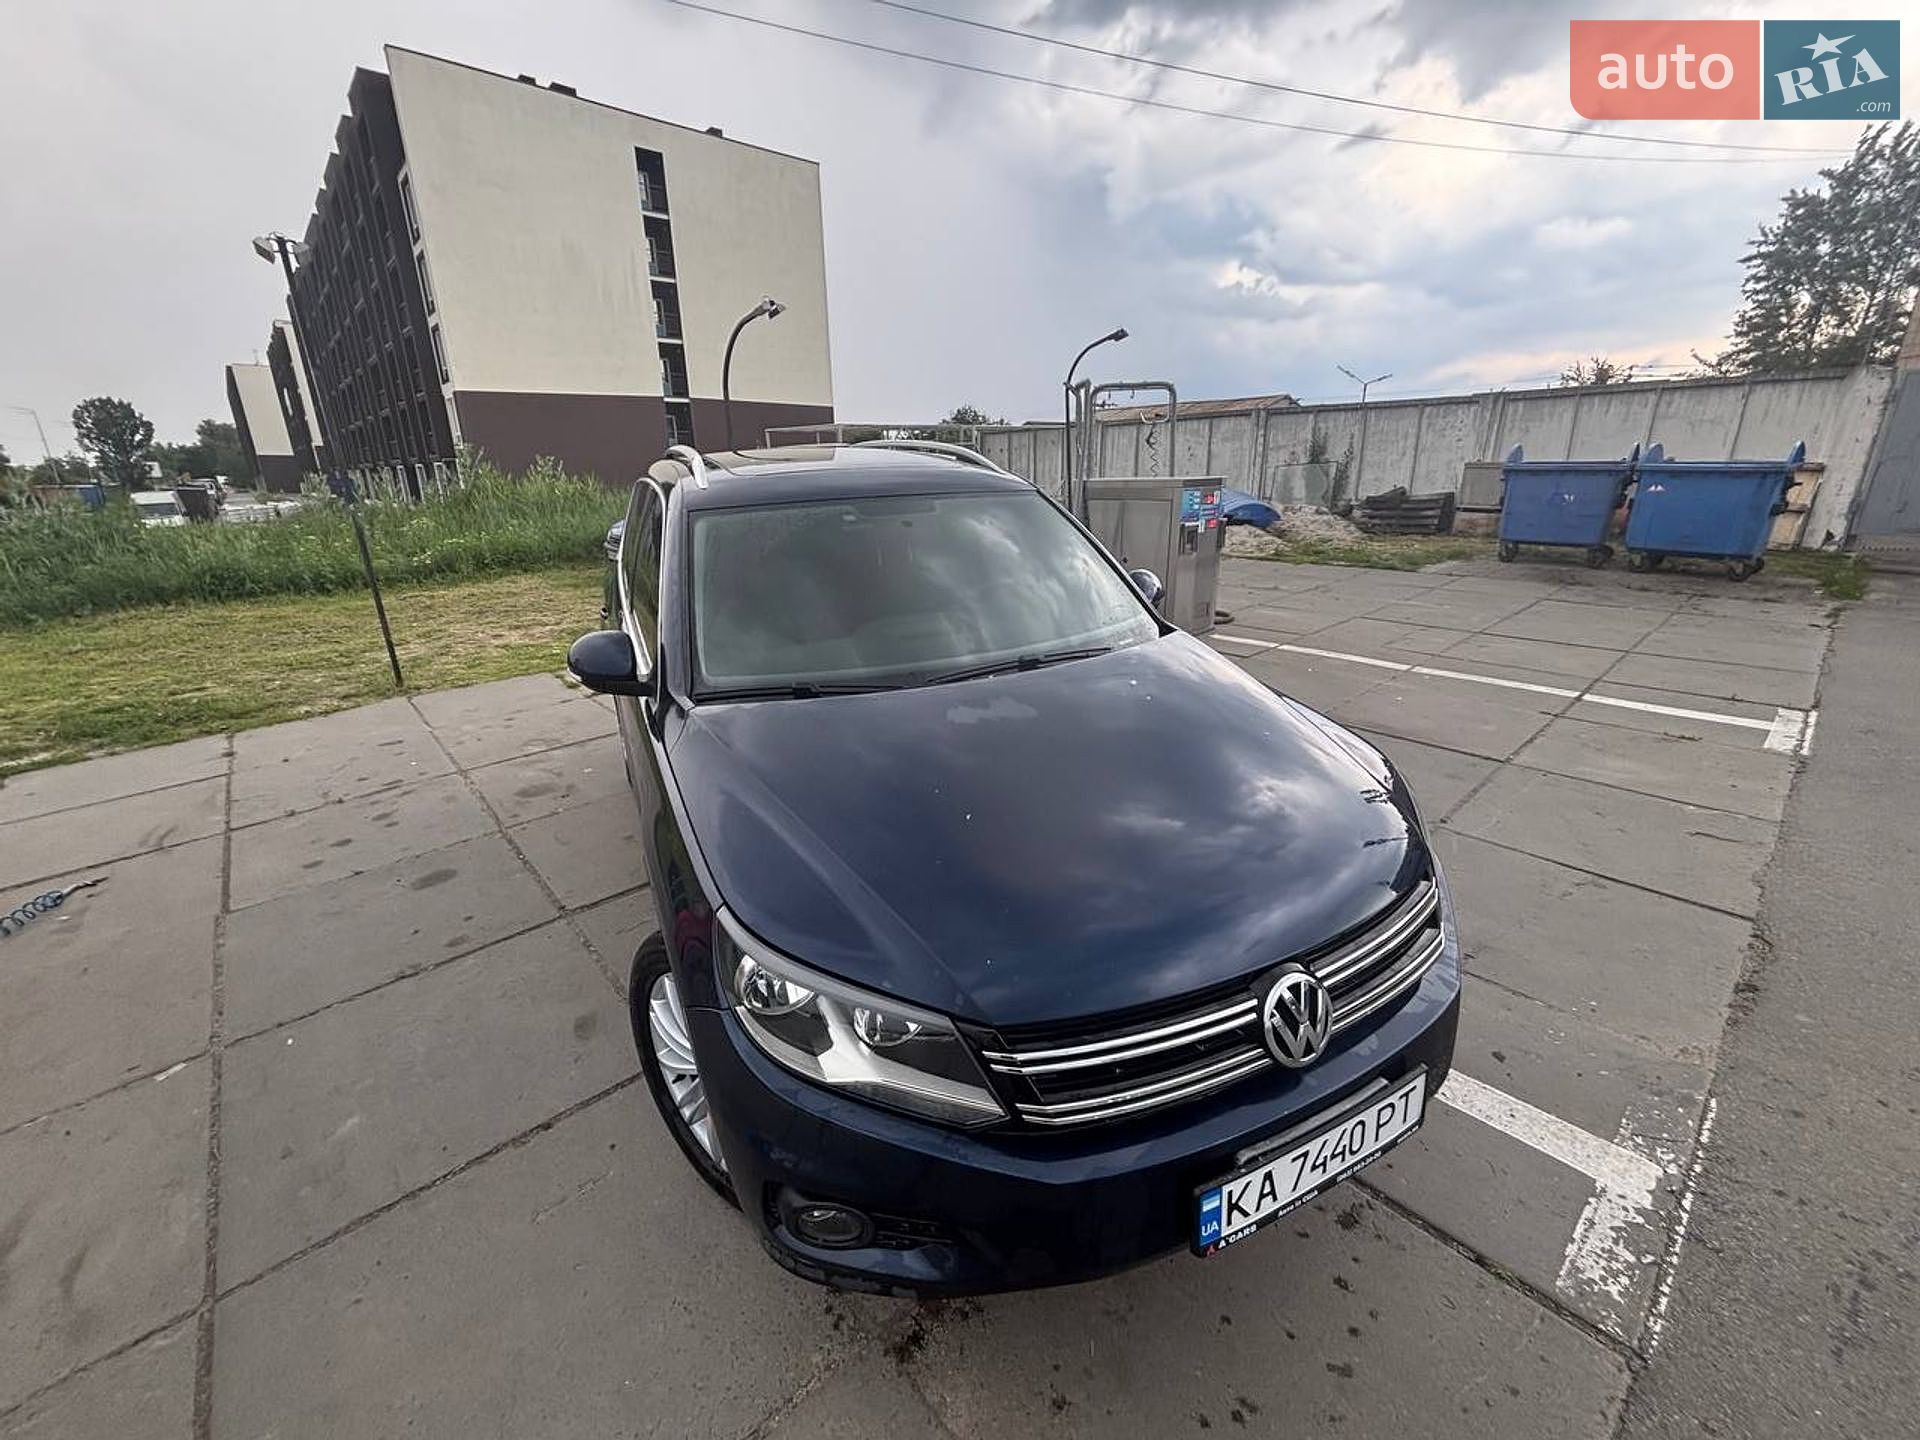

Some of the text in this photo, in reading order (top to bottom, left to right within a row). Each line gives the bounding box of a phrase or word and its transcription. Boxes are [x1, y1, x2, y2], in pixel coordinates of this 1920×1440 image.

[1226, 1171, 1278, 1227] KA
[1291, 1119, 1366, 1192] 7440
[1374, 1085, 1418, 1142] PT
[1201, 1220, 1219, 1236] UA
